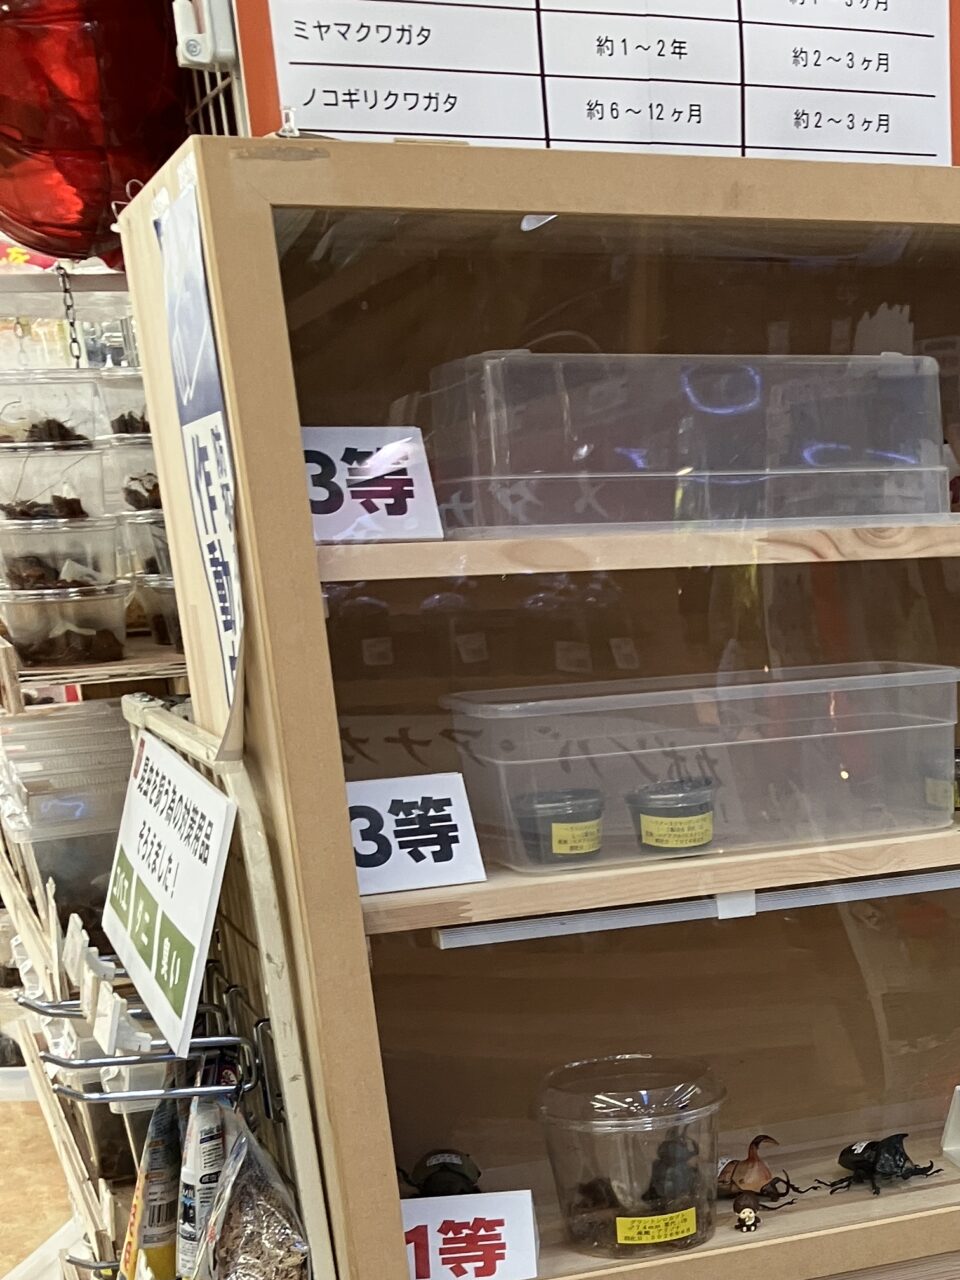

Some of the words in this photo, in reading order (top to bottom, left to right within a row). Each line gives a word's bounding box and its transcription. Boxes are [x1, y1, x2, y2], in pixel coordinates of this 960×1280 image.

[293, 19, 432, 46] ミヤマクワガタ
[302, 88, 459, 114] ノコギリクワガタ
[350, 796, 459, 869] 3等
[403, 1214, 508, 1280] 1等
